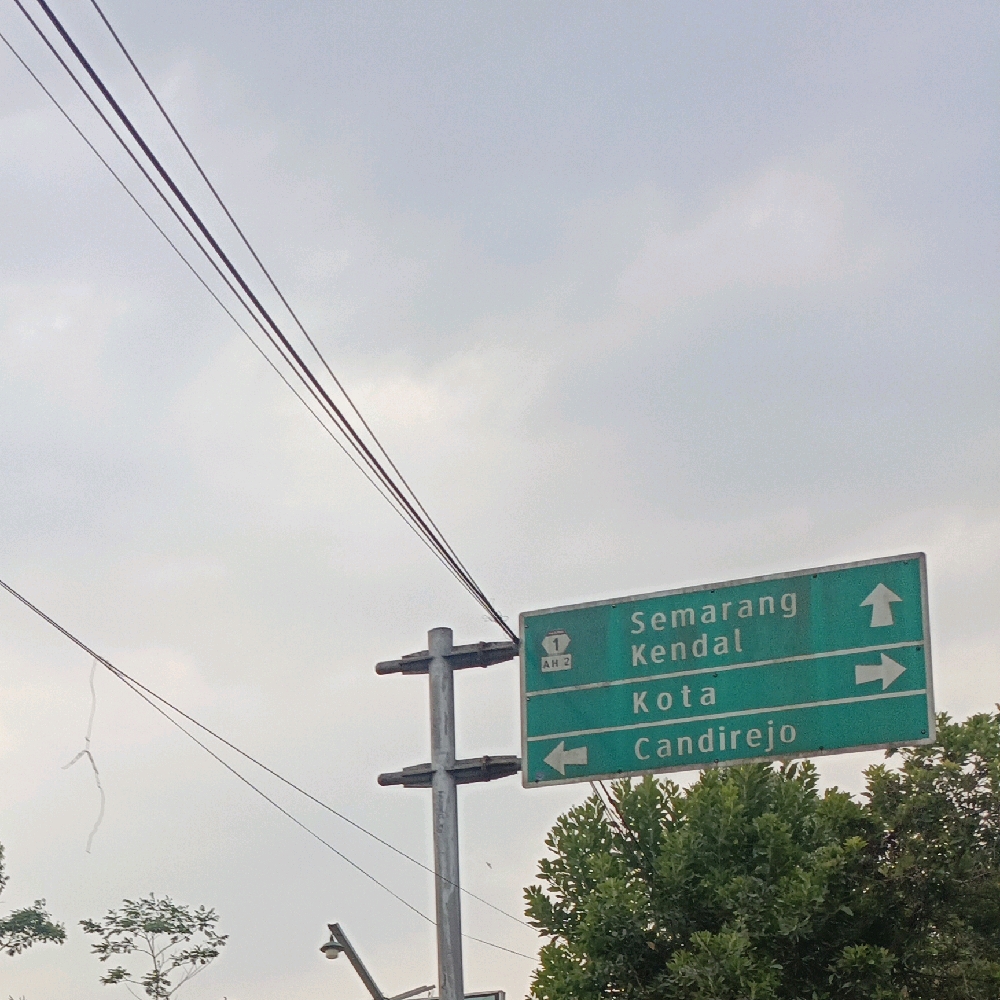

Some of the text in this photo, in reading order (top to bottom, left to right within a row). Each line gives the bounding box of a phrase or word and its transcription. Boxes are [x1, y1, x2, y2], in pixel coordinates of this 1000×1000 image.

[630, 592, 798, 634] Semarang
[552, 637, 559, 651] 1
[631, 628, 743, 667] Kendal
[543, 657, 570, 669] AH 2
[633, 685, 717, 714] Kota
[634, 720, 797, 760] Candirejo
